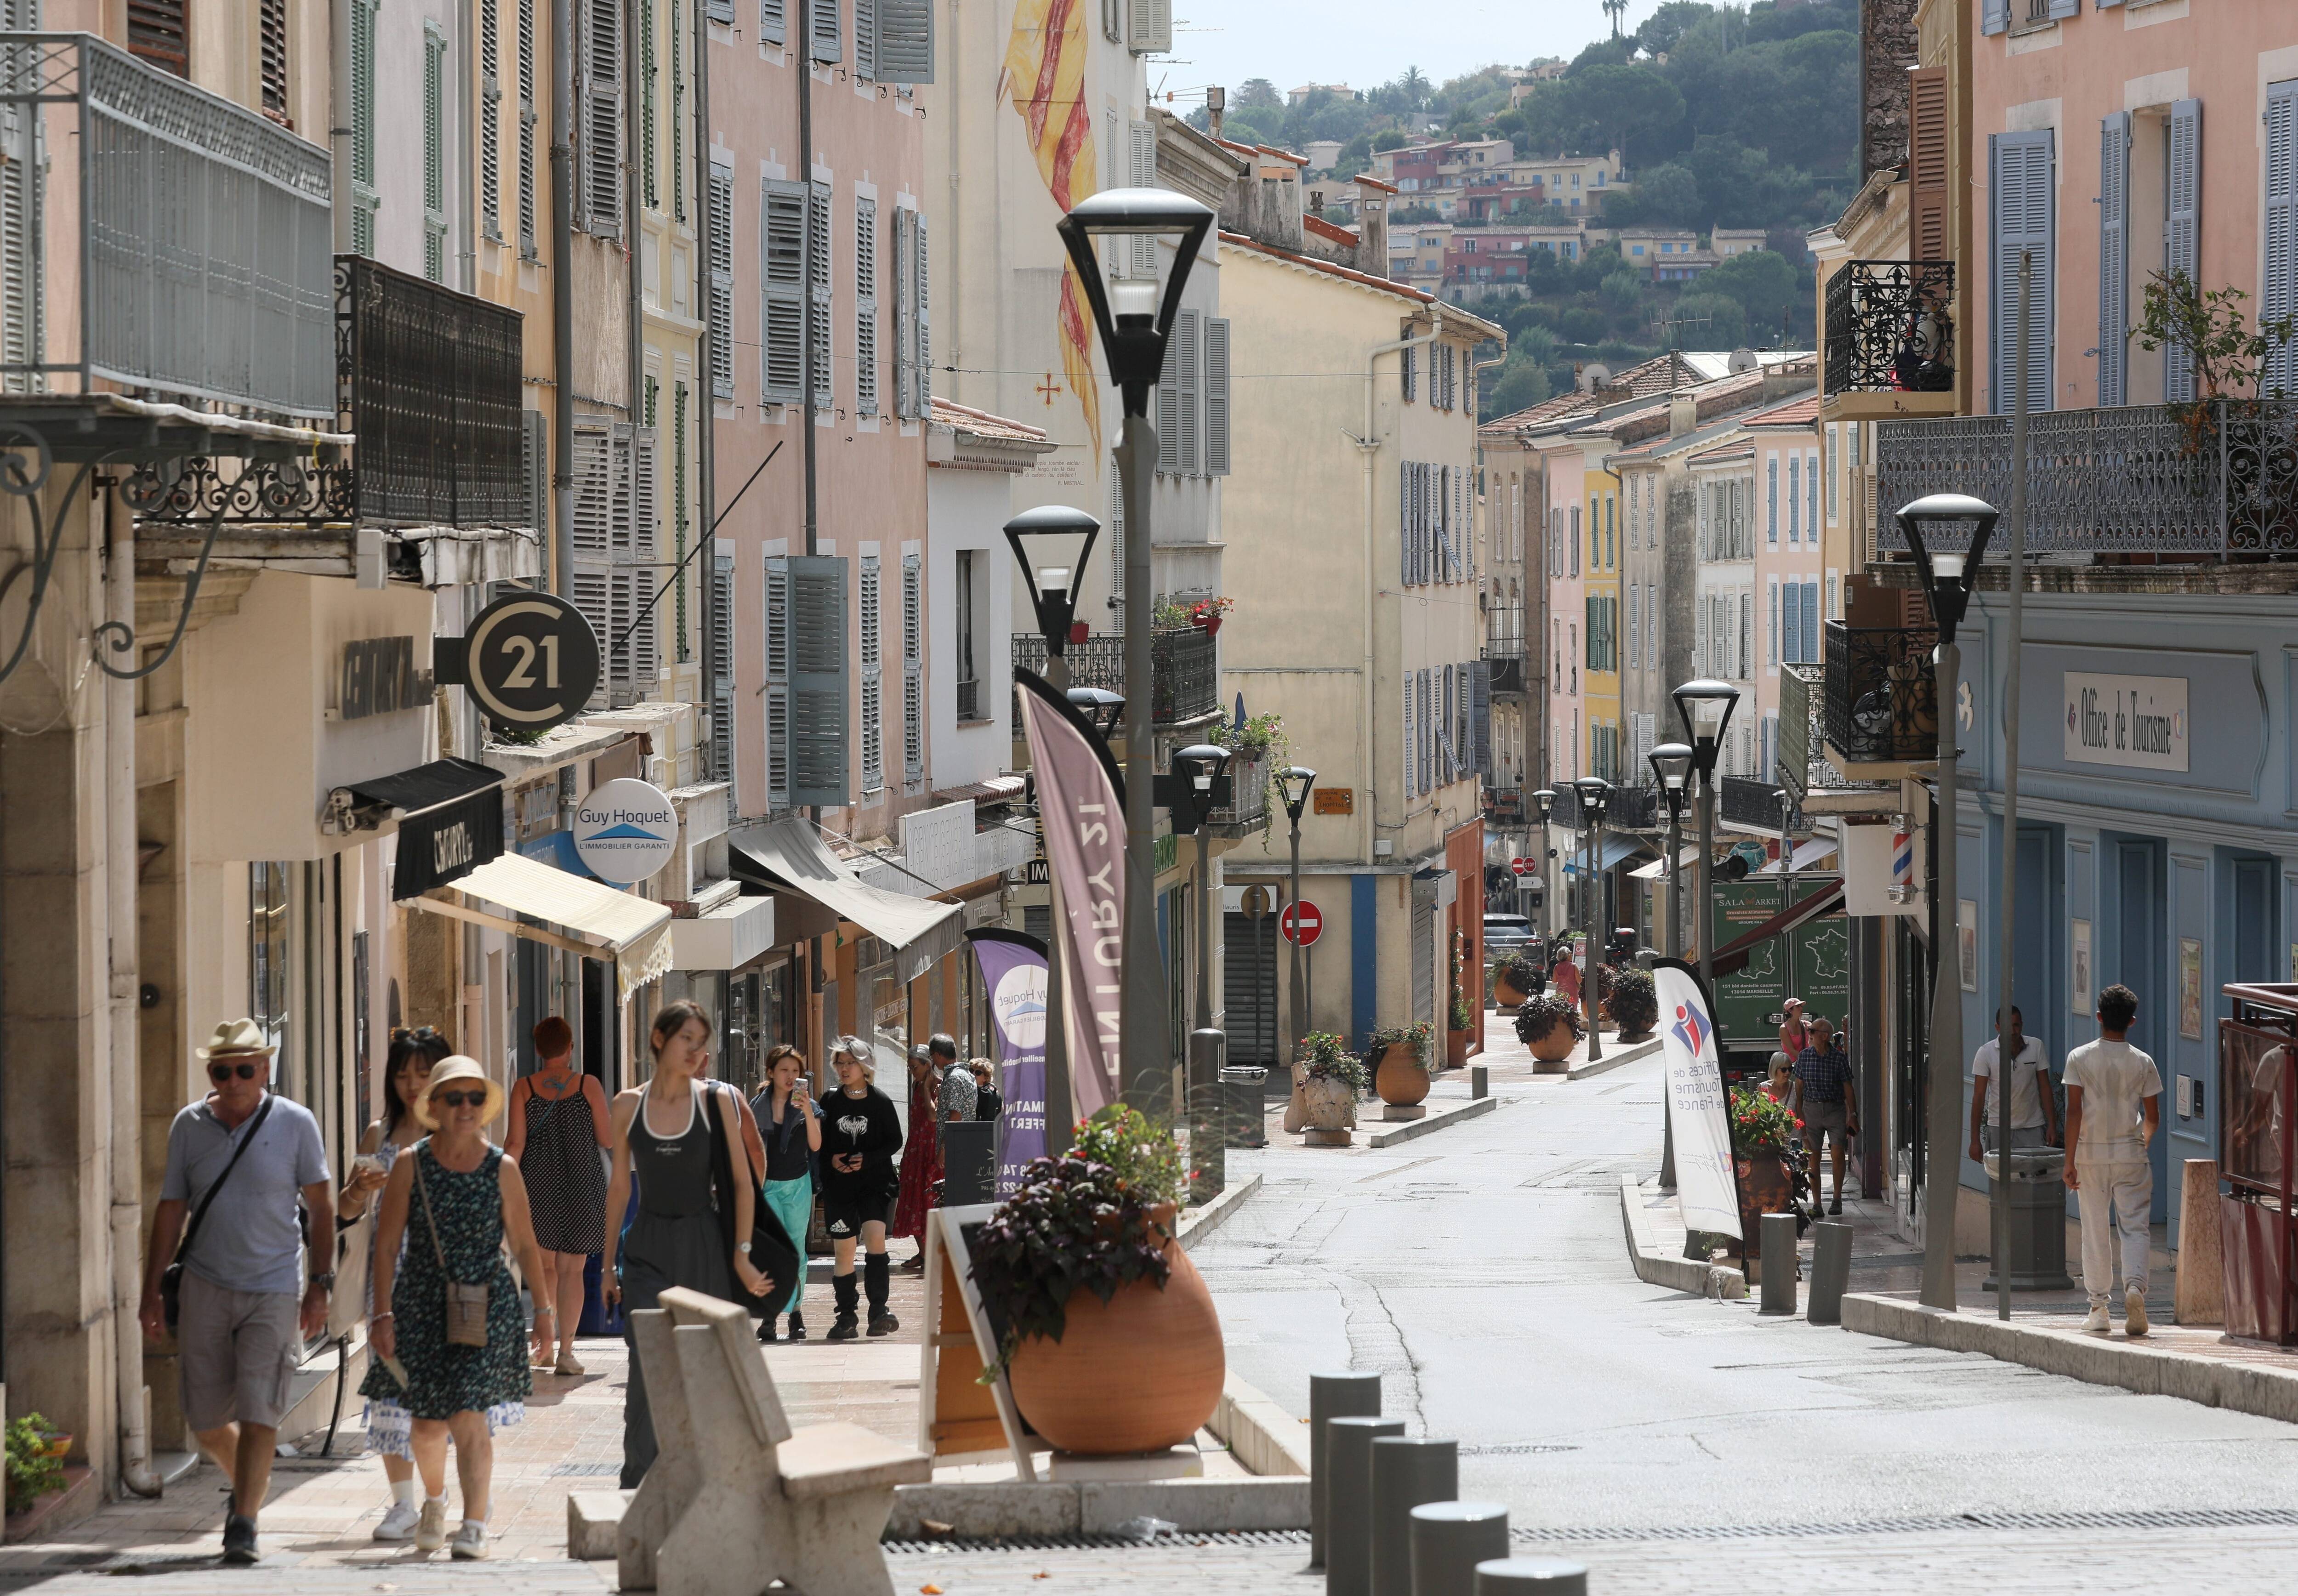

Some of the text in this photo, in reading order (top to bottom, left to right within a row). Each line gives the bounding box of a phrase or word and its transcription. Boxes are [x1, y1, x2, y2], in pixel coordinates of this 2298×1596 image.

[500, 635, 559, 688] 21
[2081, 687, 2171, 755] Office de Tourisme
[580, 809, 669, 826] Guy Hoquet
